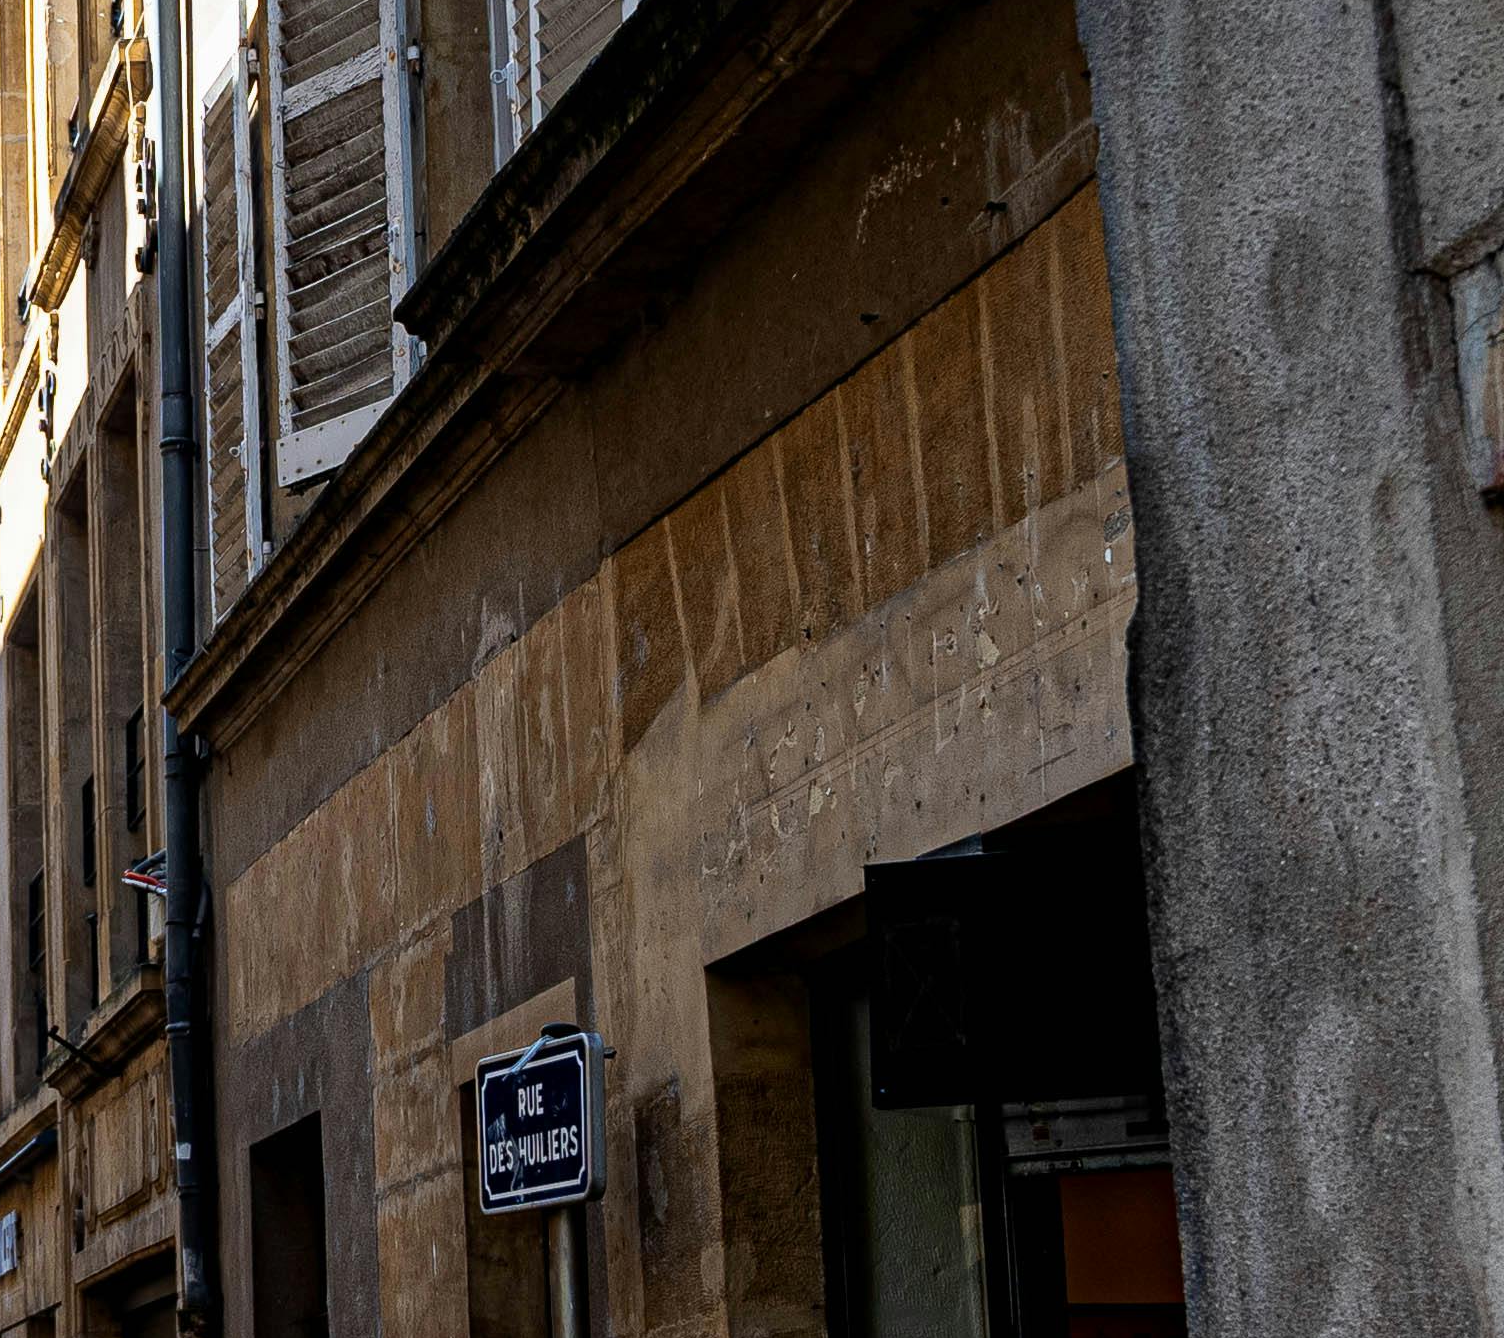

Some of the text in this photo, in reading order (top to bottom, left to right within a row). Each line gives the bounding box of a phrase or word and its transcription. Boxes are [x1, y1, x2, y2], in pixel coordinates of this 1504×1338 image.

[517, 1082, 544, 1118] RUE
[489, 1125, 579, 1175] DES HUILIERS
